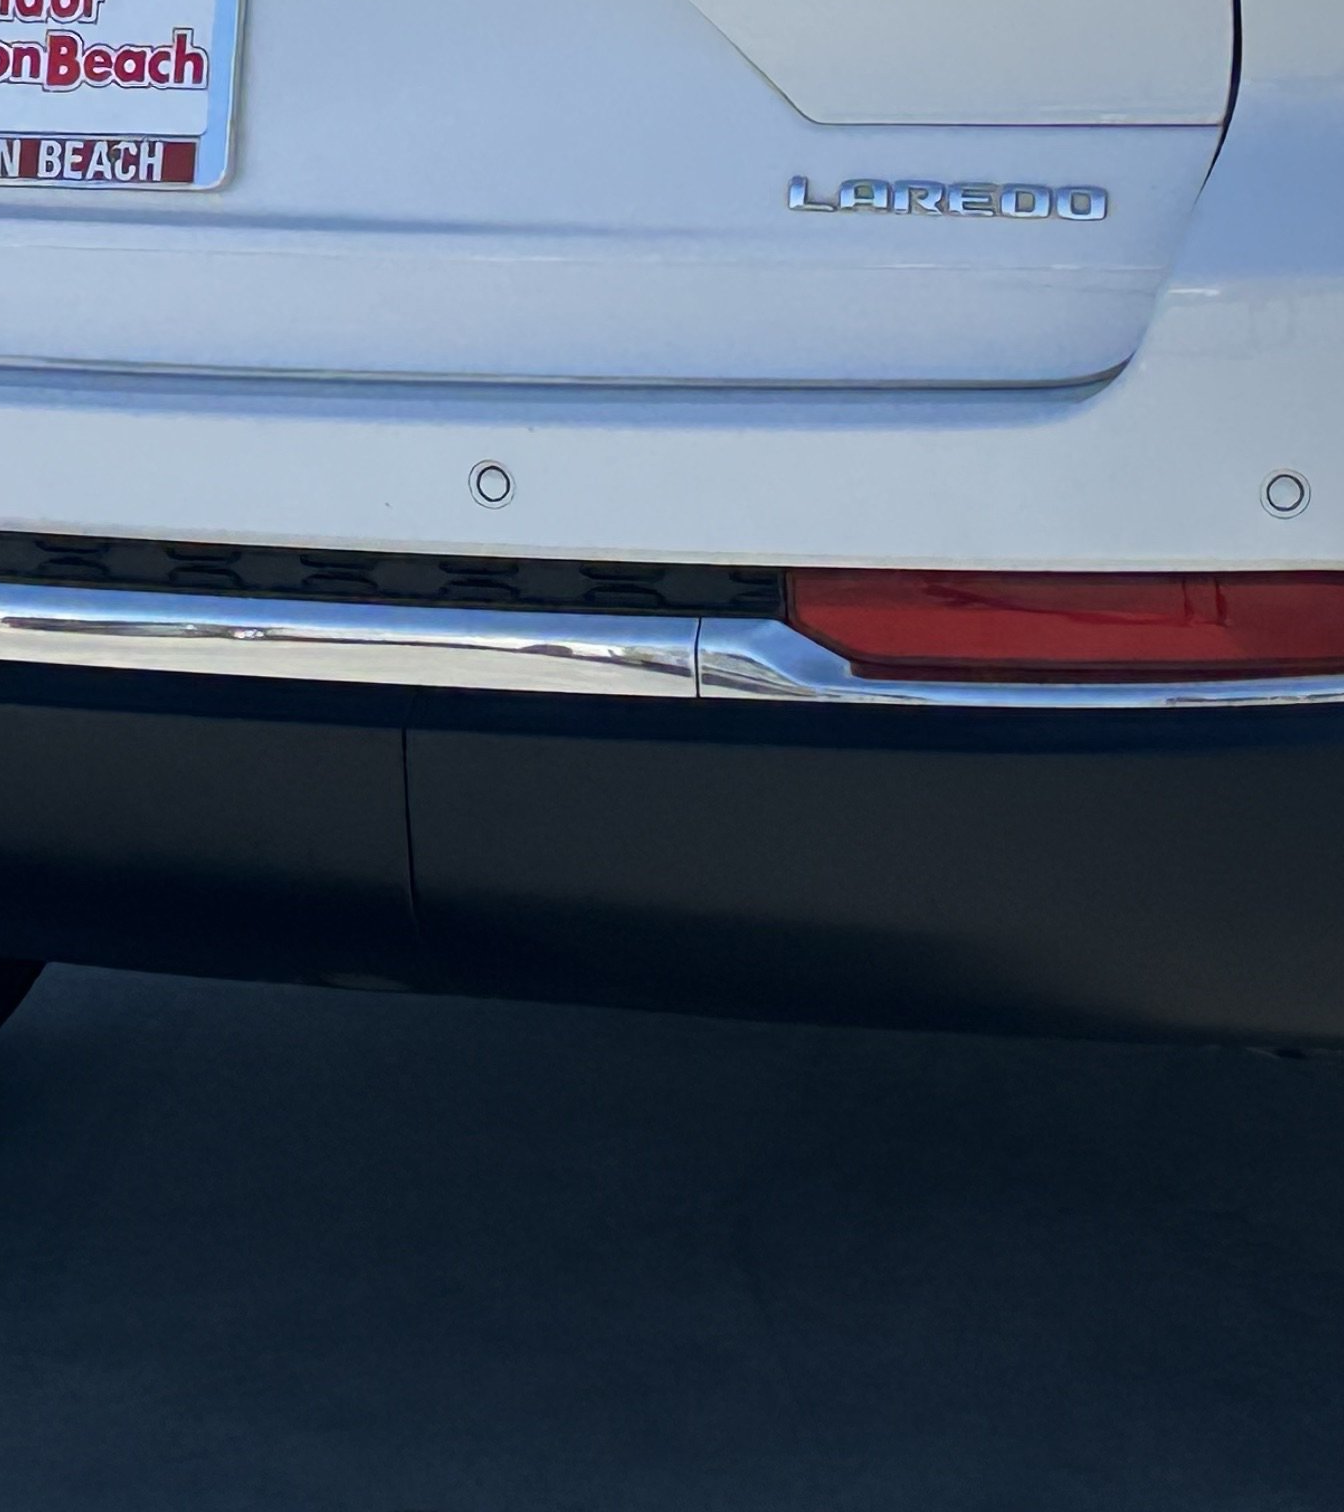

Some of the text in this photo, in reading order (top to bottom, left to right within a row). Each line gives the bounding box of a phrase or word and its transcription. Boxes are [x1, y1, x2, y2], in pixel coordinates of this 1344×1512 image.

[45, 31, 205, 88] Beach
[37, 140, 164, 182] BEACH
[787, 175, 1109, 222] LAREDO
